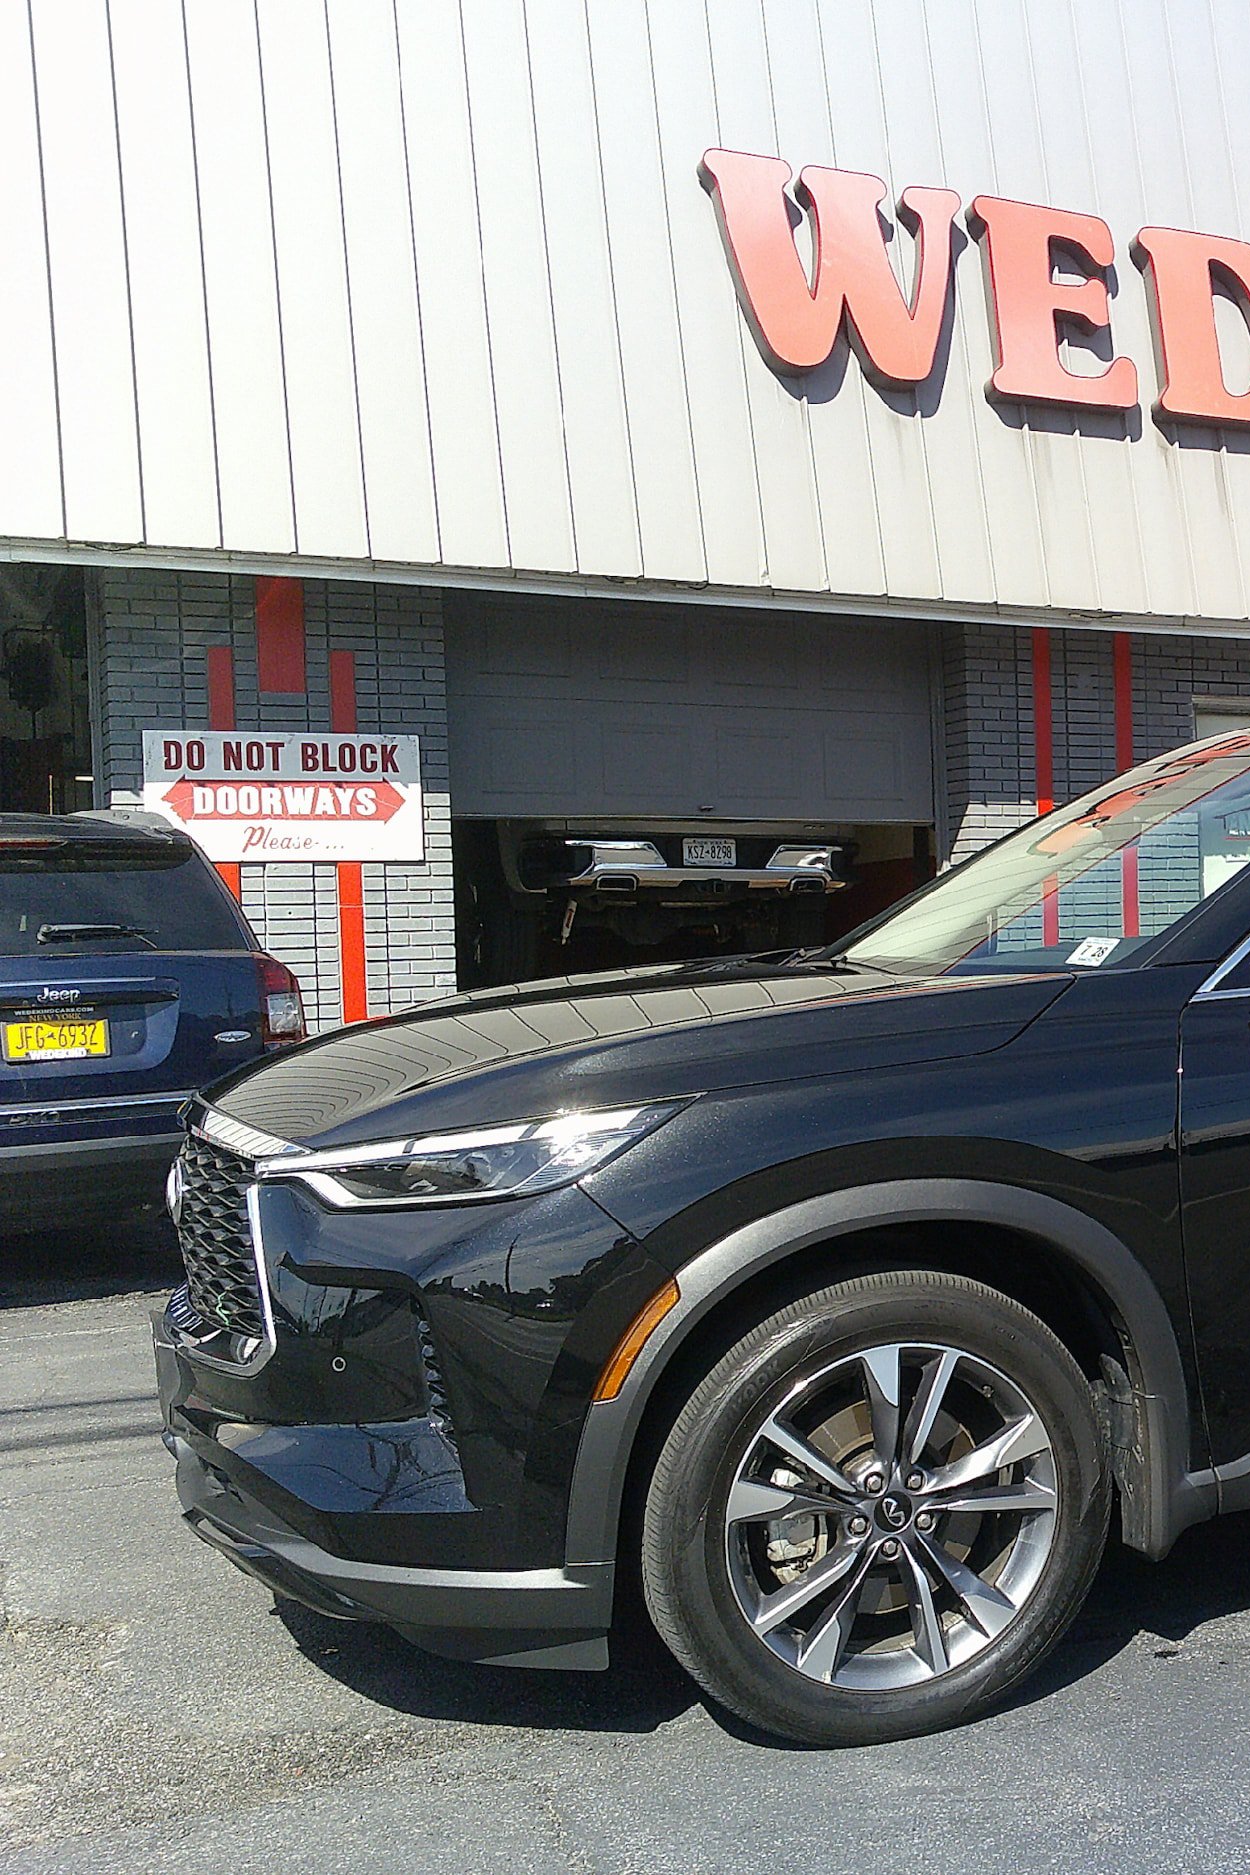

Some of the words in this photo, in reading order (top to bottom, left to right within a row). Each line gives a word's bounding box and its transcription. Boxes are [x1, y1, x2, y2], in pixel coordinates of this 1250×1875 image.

[163, 740, 206, 771] DO
[223, 741, 285, 771] NOT
[301, 743, 400, 773] BLOCK
[193, 786, 378, 816] DOORWAYS
[37, 987, 81, 1003] Jeep
